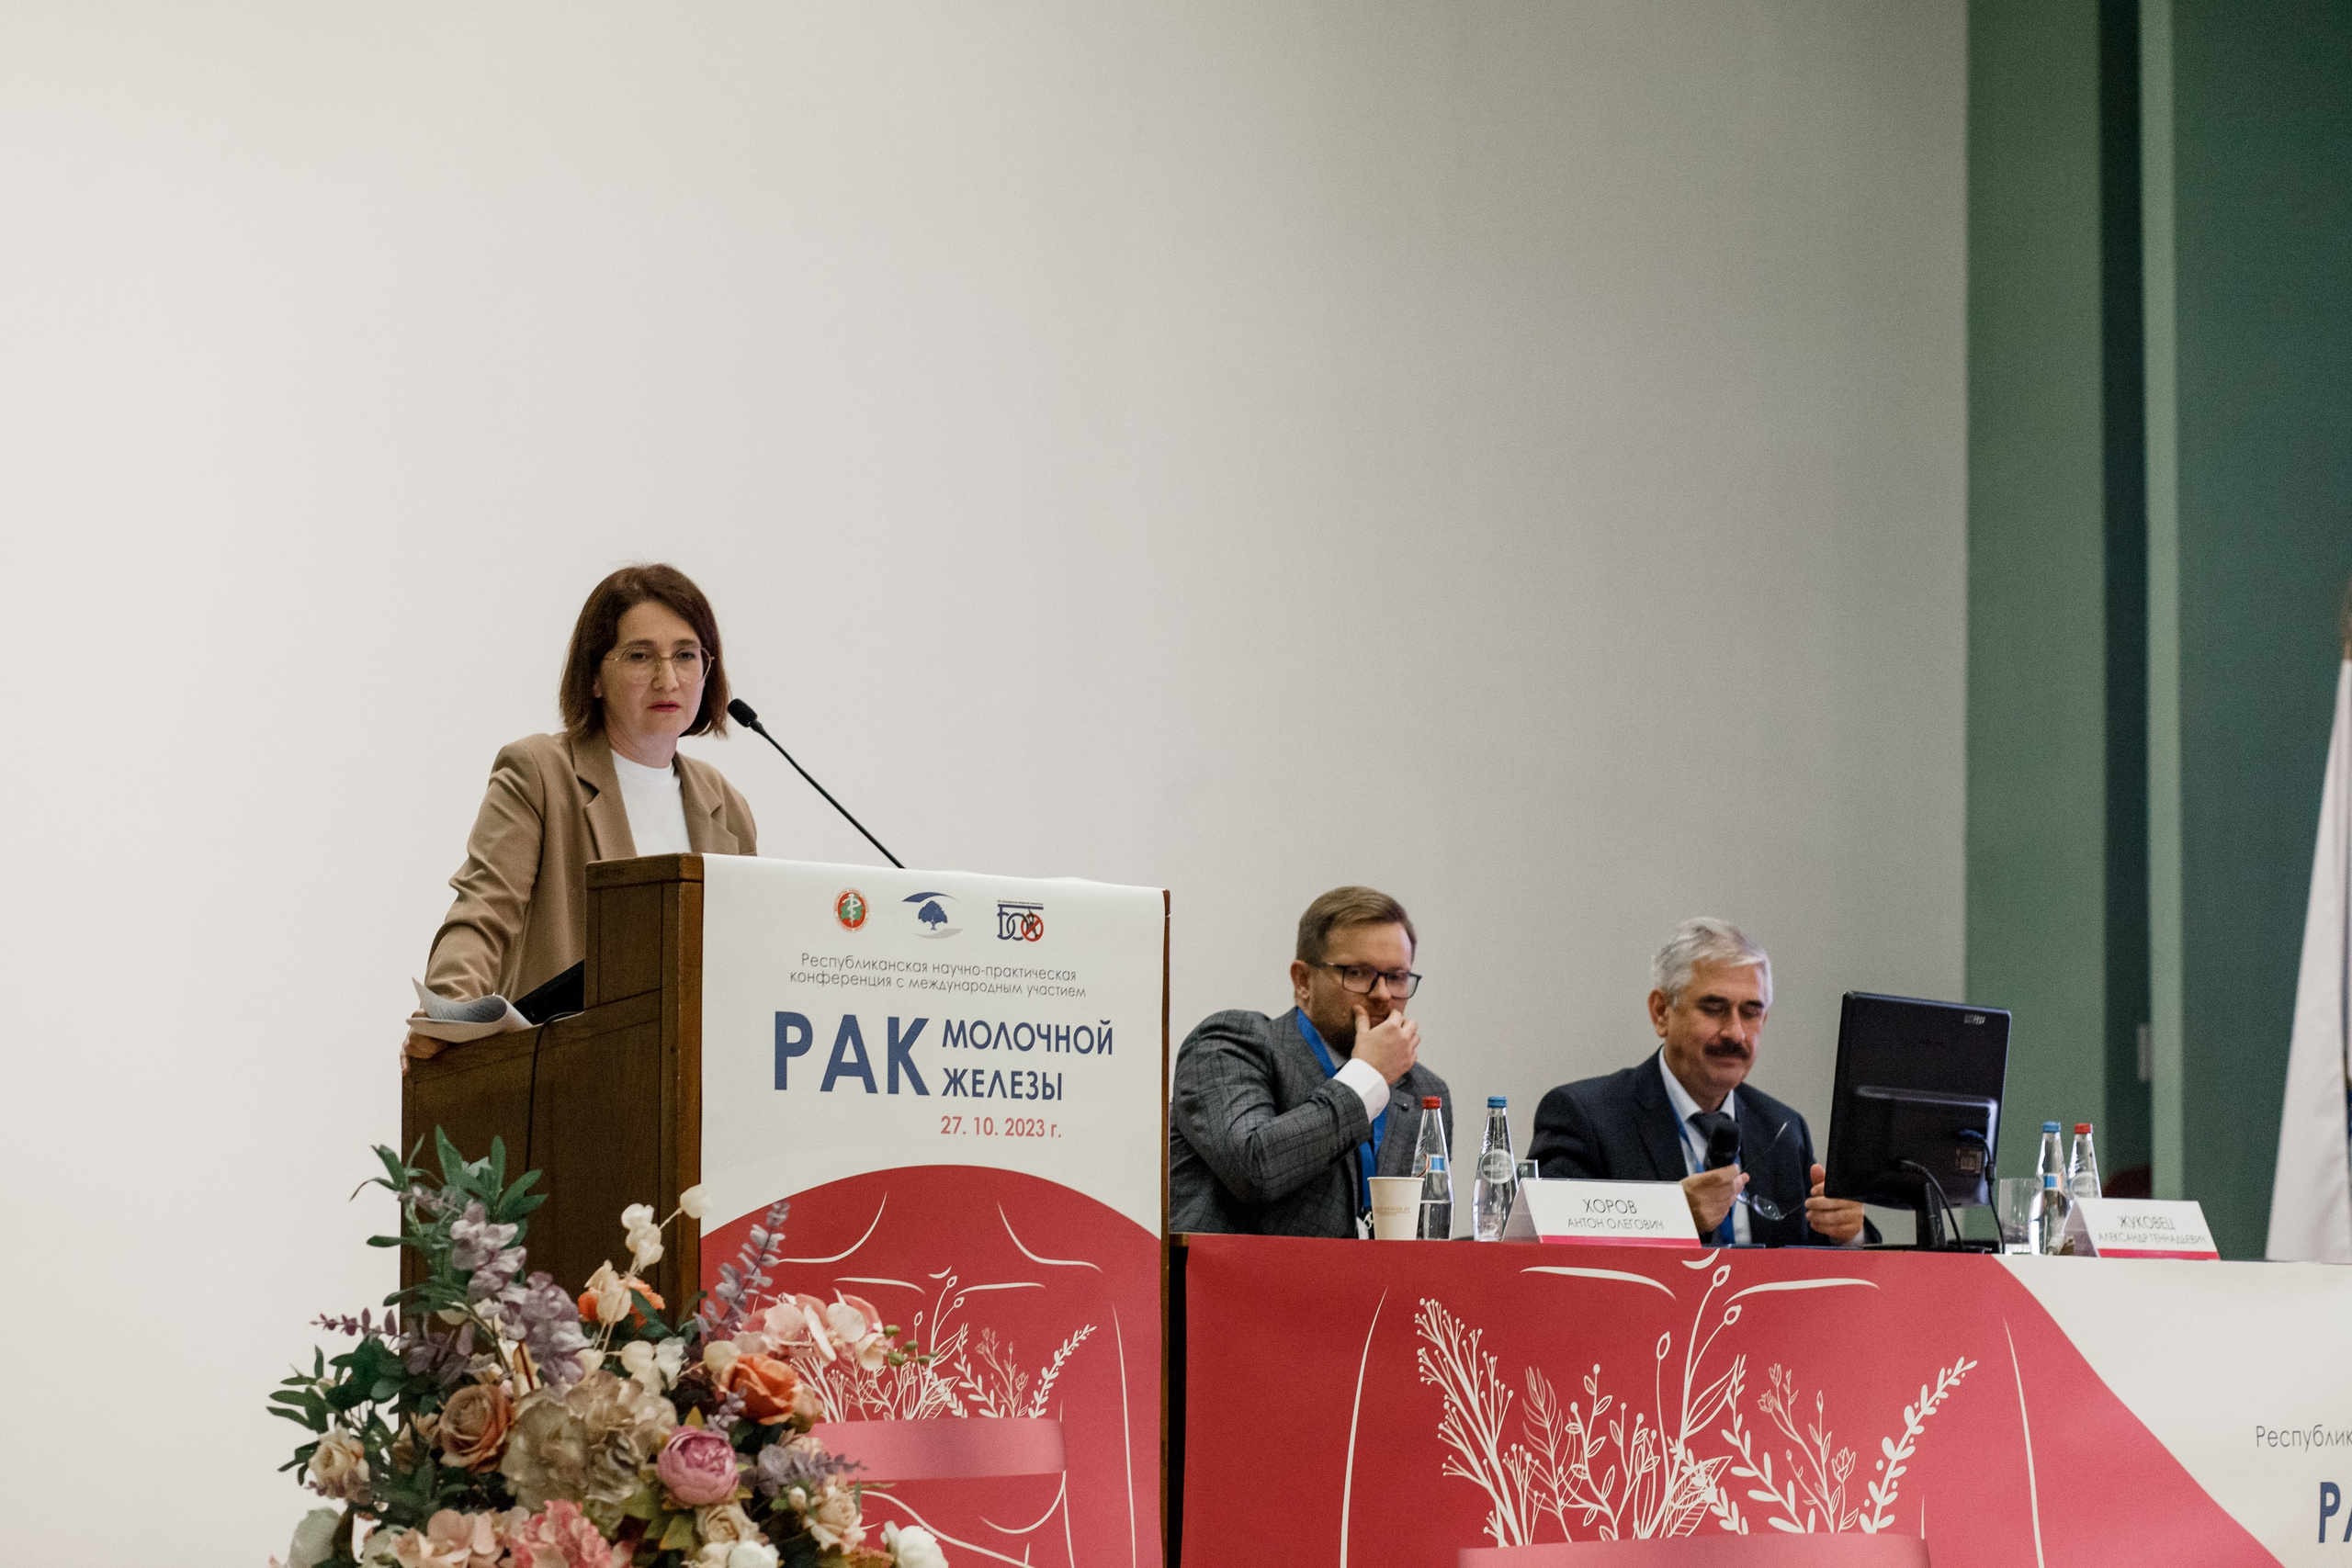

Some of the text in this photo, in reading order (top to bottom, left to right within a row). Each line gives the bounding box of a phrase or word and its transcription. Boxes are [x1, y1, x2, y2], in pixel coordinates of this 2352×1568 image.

[801, 953, 1077, 981] Республиканская научно-практическая
[790, 970, 1086, 998] конференция с международным участием
[942, 1019, 1113, 1055] МОЛОЧНОЙ
[774, 1011, 931, 1097] РАК
[941, 1067, 1062, 1100] ЖЕЛЕЗЫ
[940, 1115, 1062, 1138] 27. 10. 2023 г.
[1582, 1199, 1637, 1213] ХОРОВ
[1567, 1217, 1664, 1230] АНТОН ОЛЕГОВИЧ
[2117, 1215, 2177, 1230] ЖУКОВЕЦ
[2098, 1232, 2206, 1245] АЛЕКСАНДР ГЕННАДЬЕВИЧ
[2318, 1482, 2352, 1543] Р
